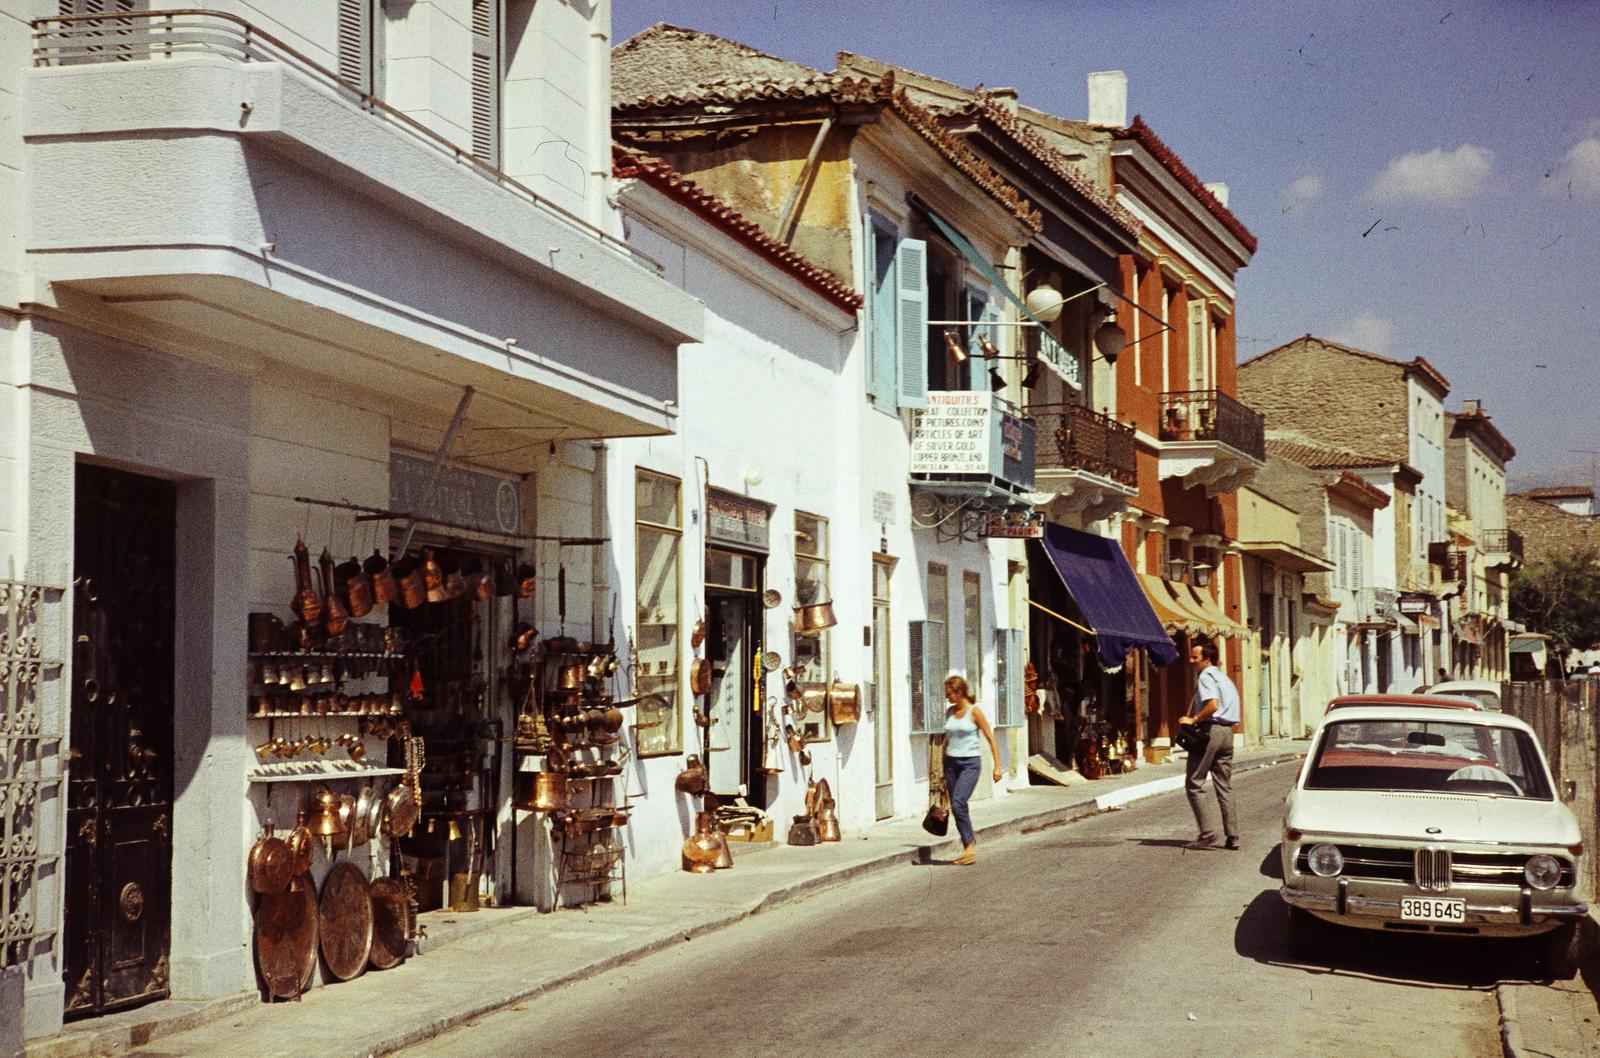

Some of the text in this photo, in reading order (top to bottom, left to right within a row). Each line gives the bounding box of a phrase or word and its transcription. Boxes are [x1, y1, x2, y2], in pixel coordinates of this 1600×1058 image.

[927, 395, 979, 405] NTIQUITIES
[946, 407, 988, 417] COLLECTION
[914, 430, 983, 440] ARTICLES OF ART
[913, 441, 923, 451] OF
